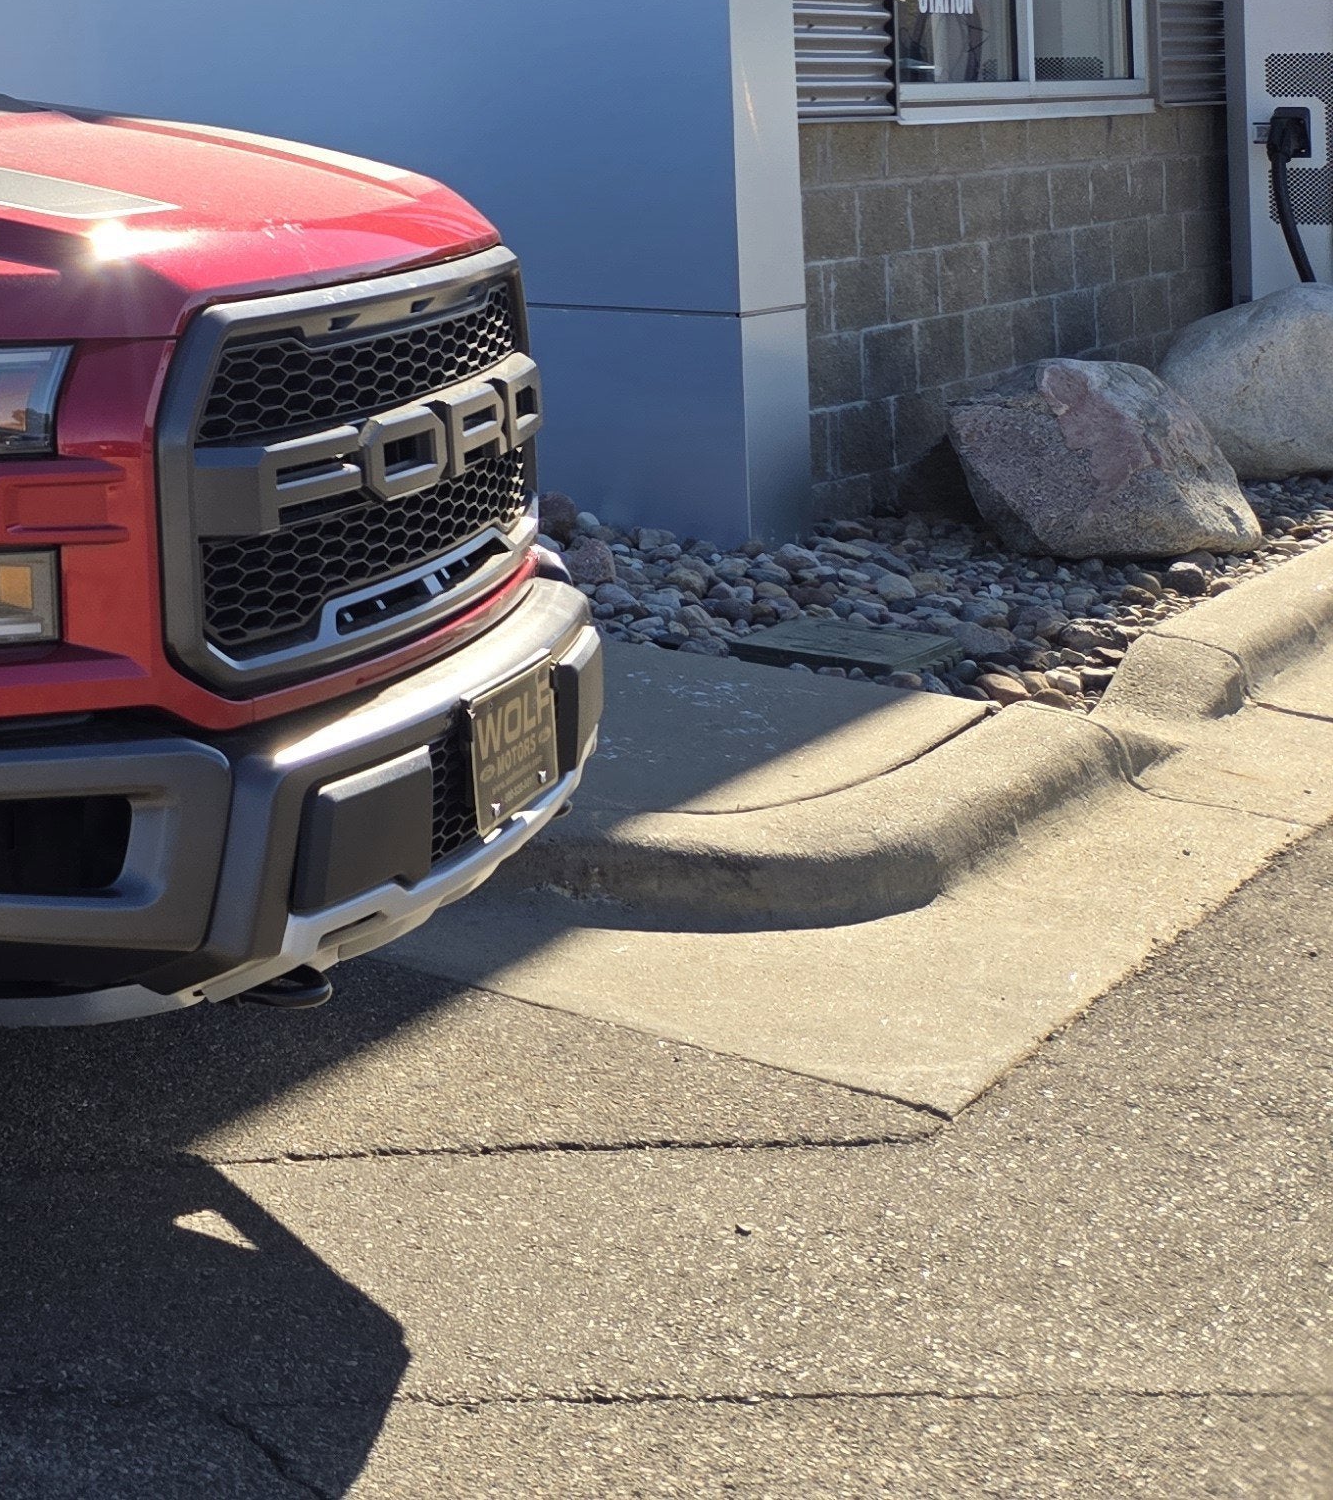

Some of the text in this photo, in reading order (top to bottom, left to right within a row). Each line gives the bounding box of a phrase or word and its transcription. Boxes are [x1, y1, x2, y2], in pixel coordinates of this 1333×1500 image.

[257, 352, 541, 536] FORD
[476, 677, 551, 761] WOLF
[497, 732, 536, 777] MOTORS
